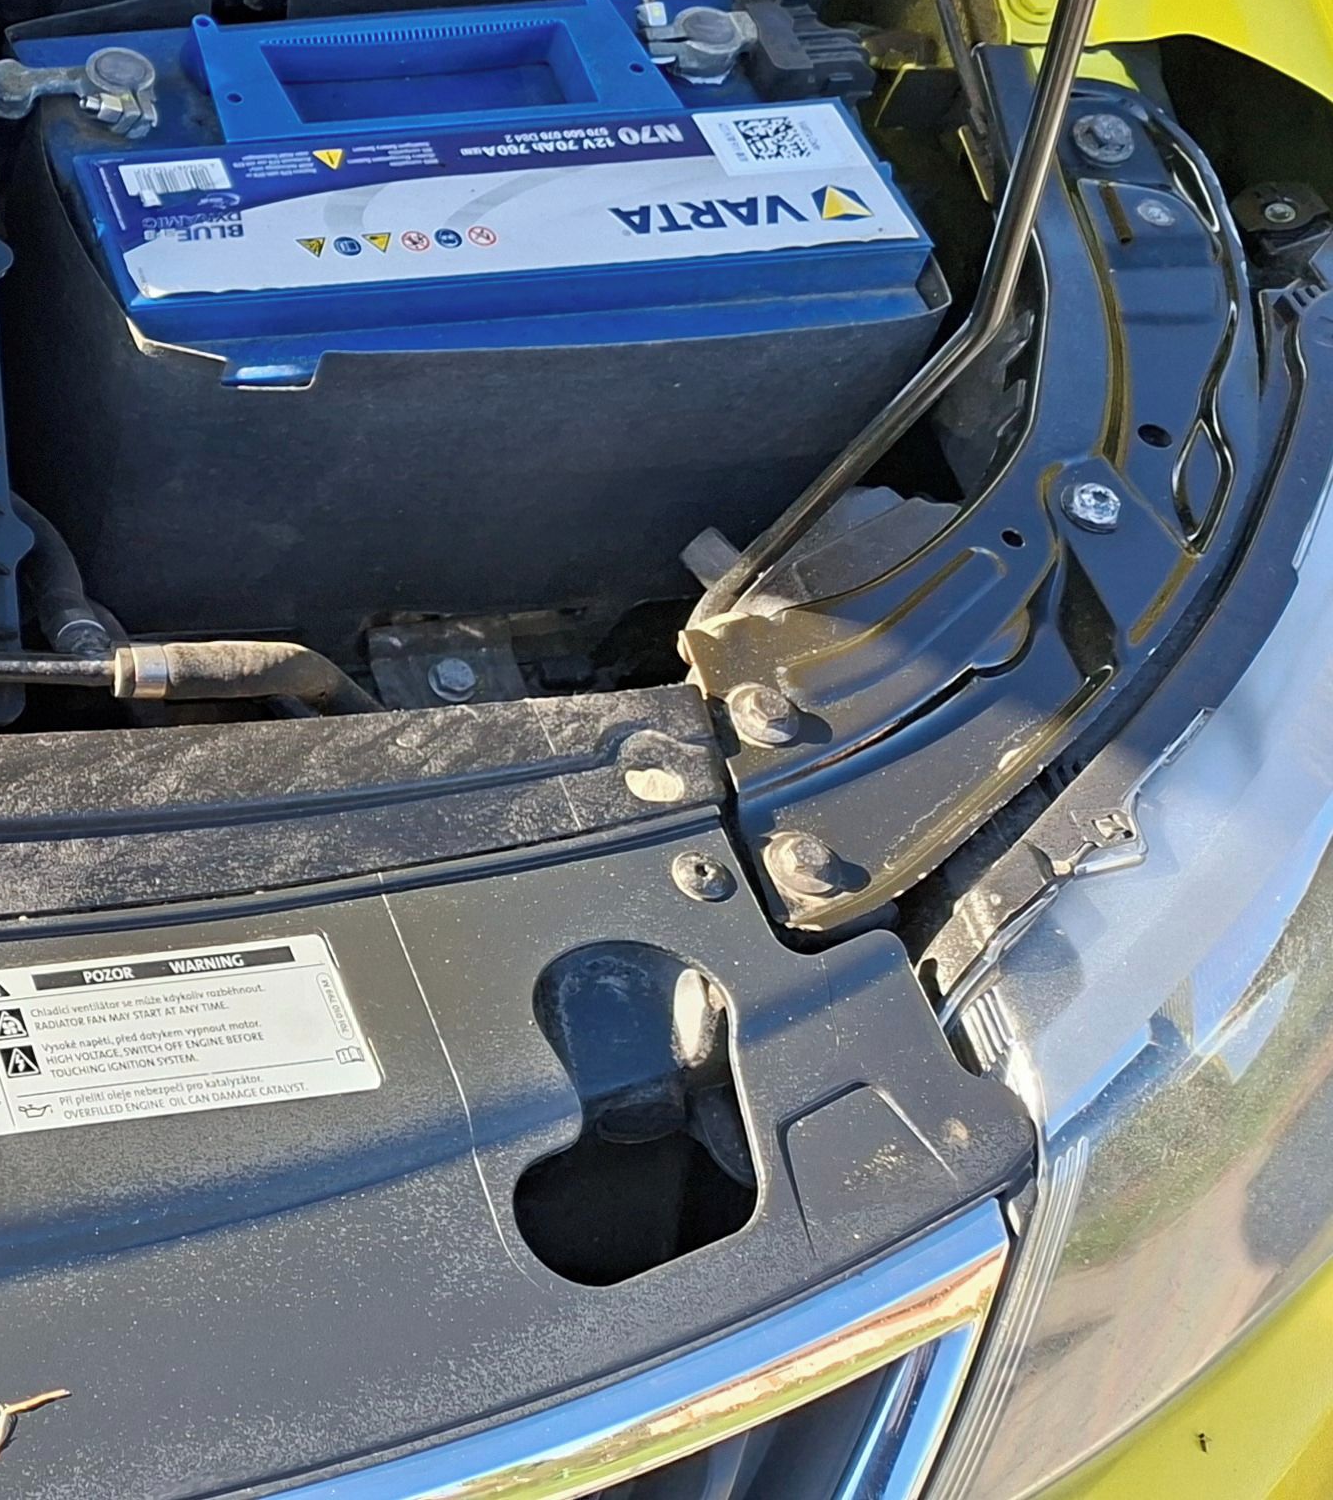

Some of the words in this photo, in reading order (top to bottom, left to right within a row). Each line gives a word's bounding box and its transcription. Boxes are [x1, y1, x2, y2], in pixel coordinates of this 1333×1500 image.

[583, 137, 615, 150] 12V
[617, 123, 684, 146] N70
[532, 138, 579, 154] 70Ah
[142, 211, 241, 229] DYNAMIC
[608, 195, 809, 234] VARTA
[178, 224, 244, 242] BLUE
[83, 966, 135, 984] POZOR
[168, 953, 245, 974] WARNING
[122, 1000, 134, 1008] se
[35, 1017, 85, 1031] RADIATOR
[87, 1014, 107, 1026] FAN
[109, 1011, 131, 1023] MAY
[134, 1008, 163, 1020] START
[165, 1007, 177, 1016] AT
[179, 1004, 199, 1014] ANY
[139, 1027, 183, 1043] dotykem
[185, 1023, 226, 1038] vypnout
[46, 1053, 74, 1065] HIGH
[123, 1043, 163, 1058] SWITCH
[165, 1039, 183, 1052] OFF
[185, 1036, 225, 1049] ENGINE
[226, 1031, 264, 1044] BEFORE
[50, 1062, 106, 1079] TOUCHING
[108, 1058, 155, 1074] IGNITION
[107, 1086, 132, 1101] oleje
[186, 1082, 203, 1093] pro
[63, 1103, 123, 1120] OVERFILLED
[125, 1099, 164, 1114] ENGINE
[169, 1095, 188, 1107] OIL
[188, 1093, 210, 1105] CAN
[211, 1088, 258, 1102] DAMAGE
